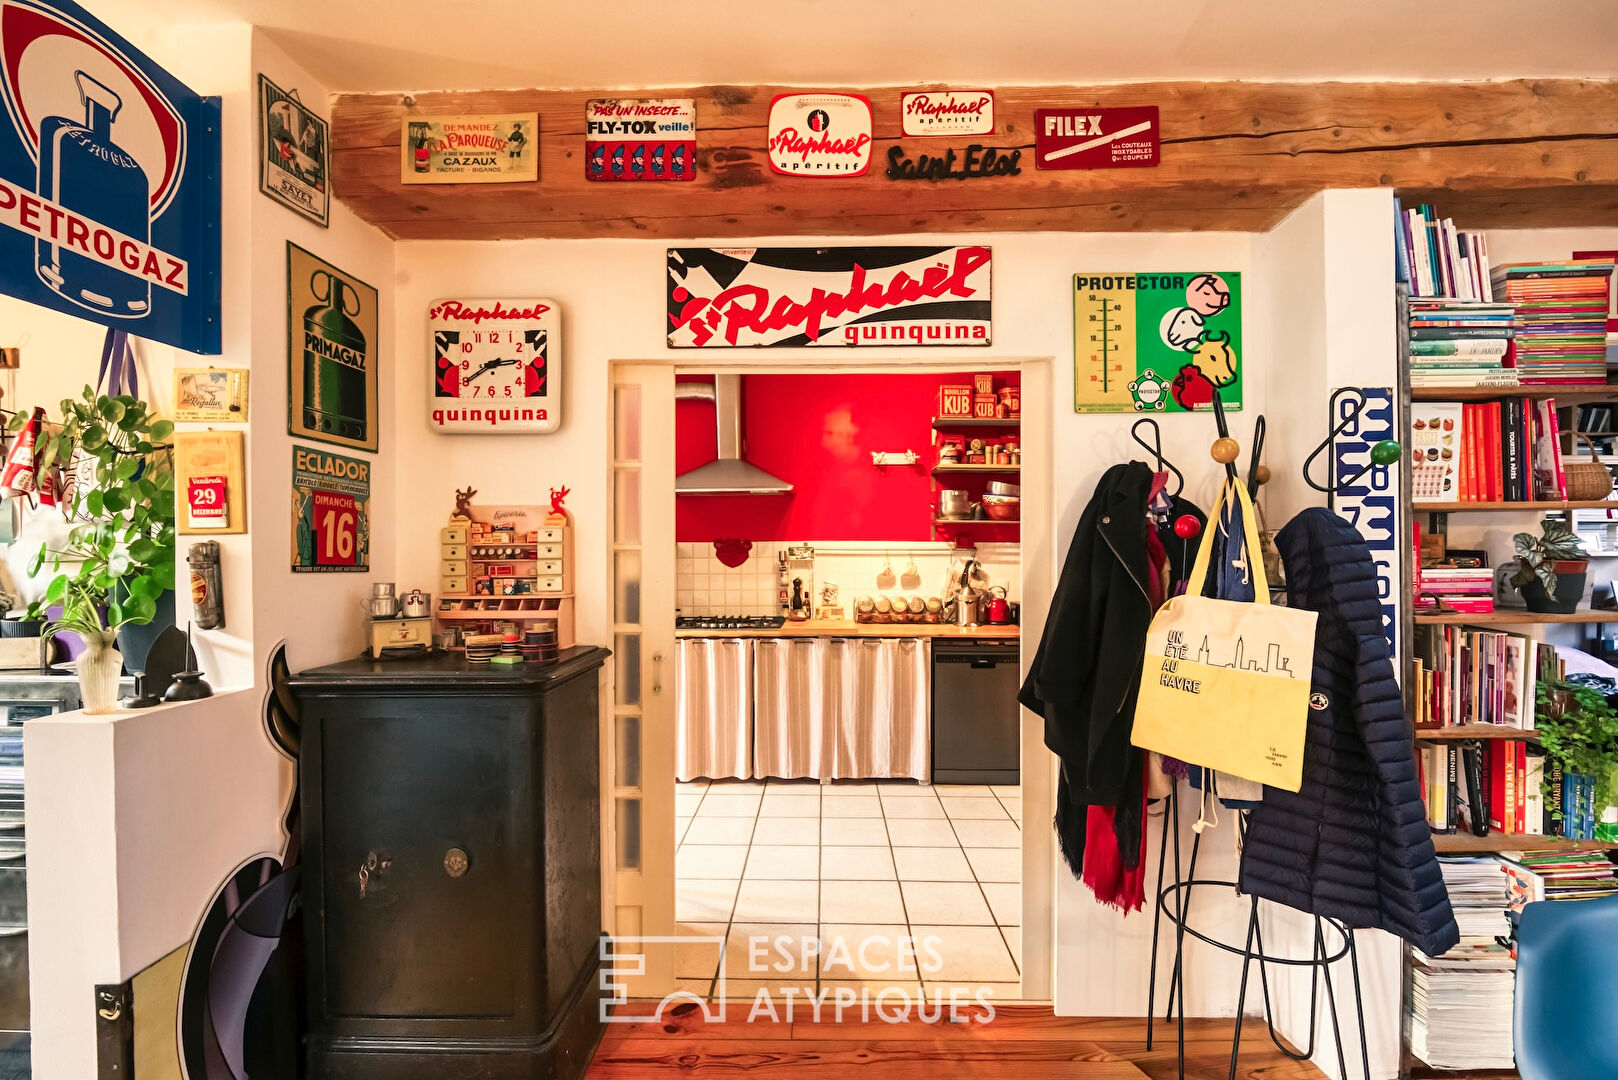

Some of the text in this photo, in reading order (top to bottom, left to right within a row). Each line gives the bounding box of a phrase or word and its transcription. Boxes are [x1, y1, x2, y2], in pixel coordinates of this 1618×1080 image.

[593, 105, 616, 116] PAS
[616, 106, 633, 116] UN
[443, 124, 498, 132] DEMANDEZ
[587, 121, 656, 134] FLY-TOX
[1044, 115, 1103, 136] FILEX
[443, 158, 497, 166] CAZAUX
[1077, 275, 1184, 290] PROTECTOR
[711, 246, 991, 346] Raphaël
[475, 333, 481, 343] 11
[490, 333, 499, 344] 12
[845, 322, 987, 344] quinquina
[304, 331, 366, 369] PRIMAGAZ
[462, 342, 472, 353] 10
[516, 342, 522, 352] 2
[462, 360, 470, 370] 9
[516, 360, 522, 370] 3
[462, 377, 470, 386] 8
[515, 377, 522, 386] 4
[977, 380, 991, 394] KUB
[474, 386, 480, 396] 7
[488, 386, 495, 396] 6
[504, 386, 511, 396] 5
[944, 396, 970, 414] KUB
[976, 402, 994, 416] KUB
[432, 407, 548, 425] quinquina
[1340, 398, 1358, 437] 9
[296, 450, 368, 481] ECLADOR
[191, 477, 222, 485] Vendredi
[194, 488, 216, 504] 29
[315, 495, 354, 508] DIMANCHE
[1342, 506, 1360, 527] 7
[323, 510, 354, 558] 16
[1374, 560, 1390, 599] 6
[1168, 630, 1184, 644] UN
[1161, 658, 1179, 673] AU
[1160, 672, 1201, 694] HAVRE
[1506, 762, 1514, 813] ECONOMIX
